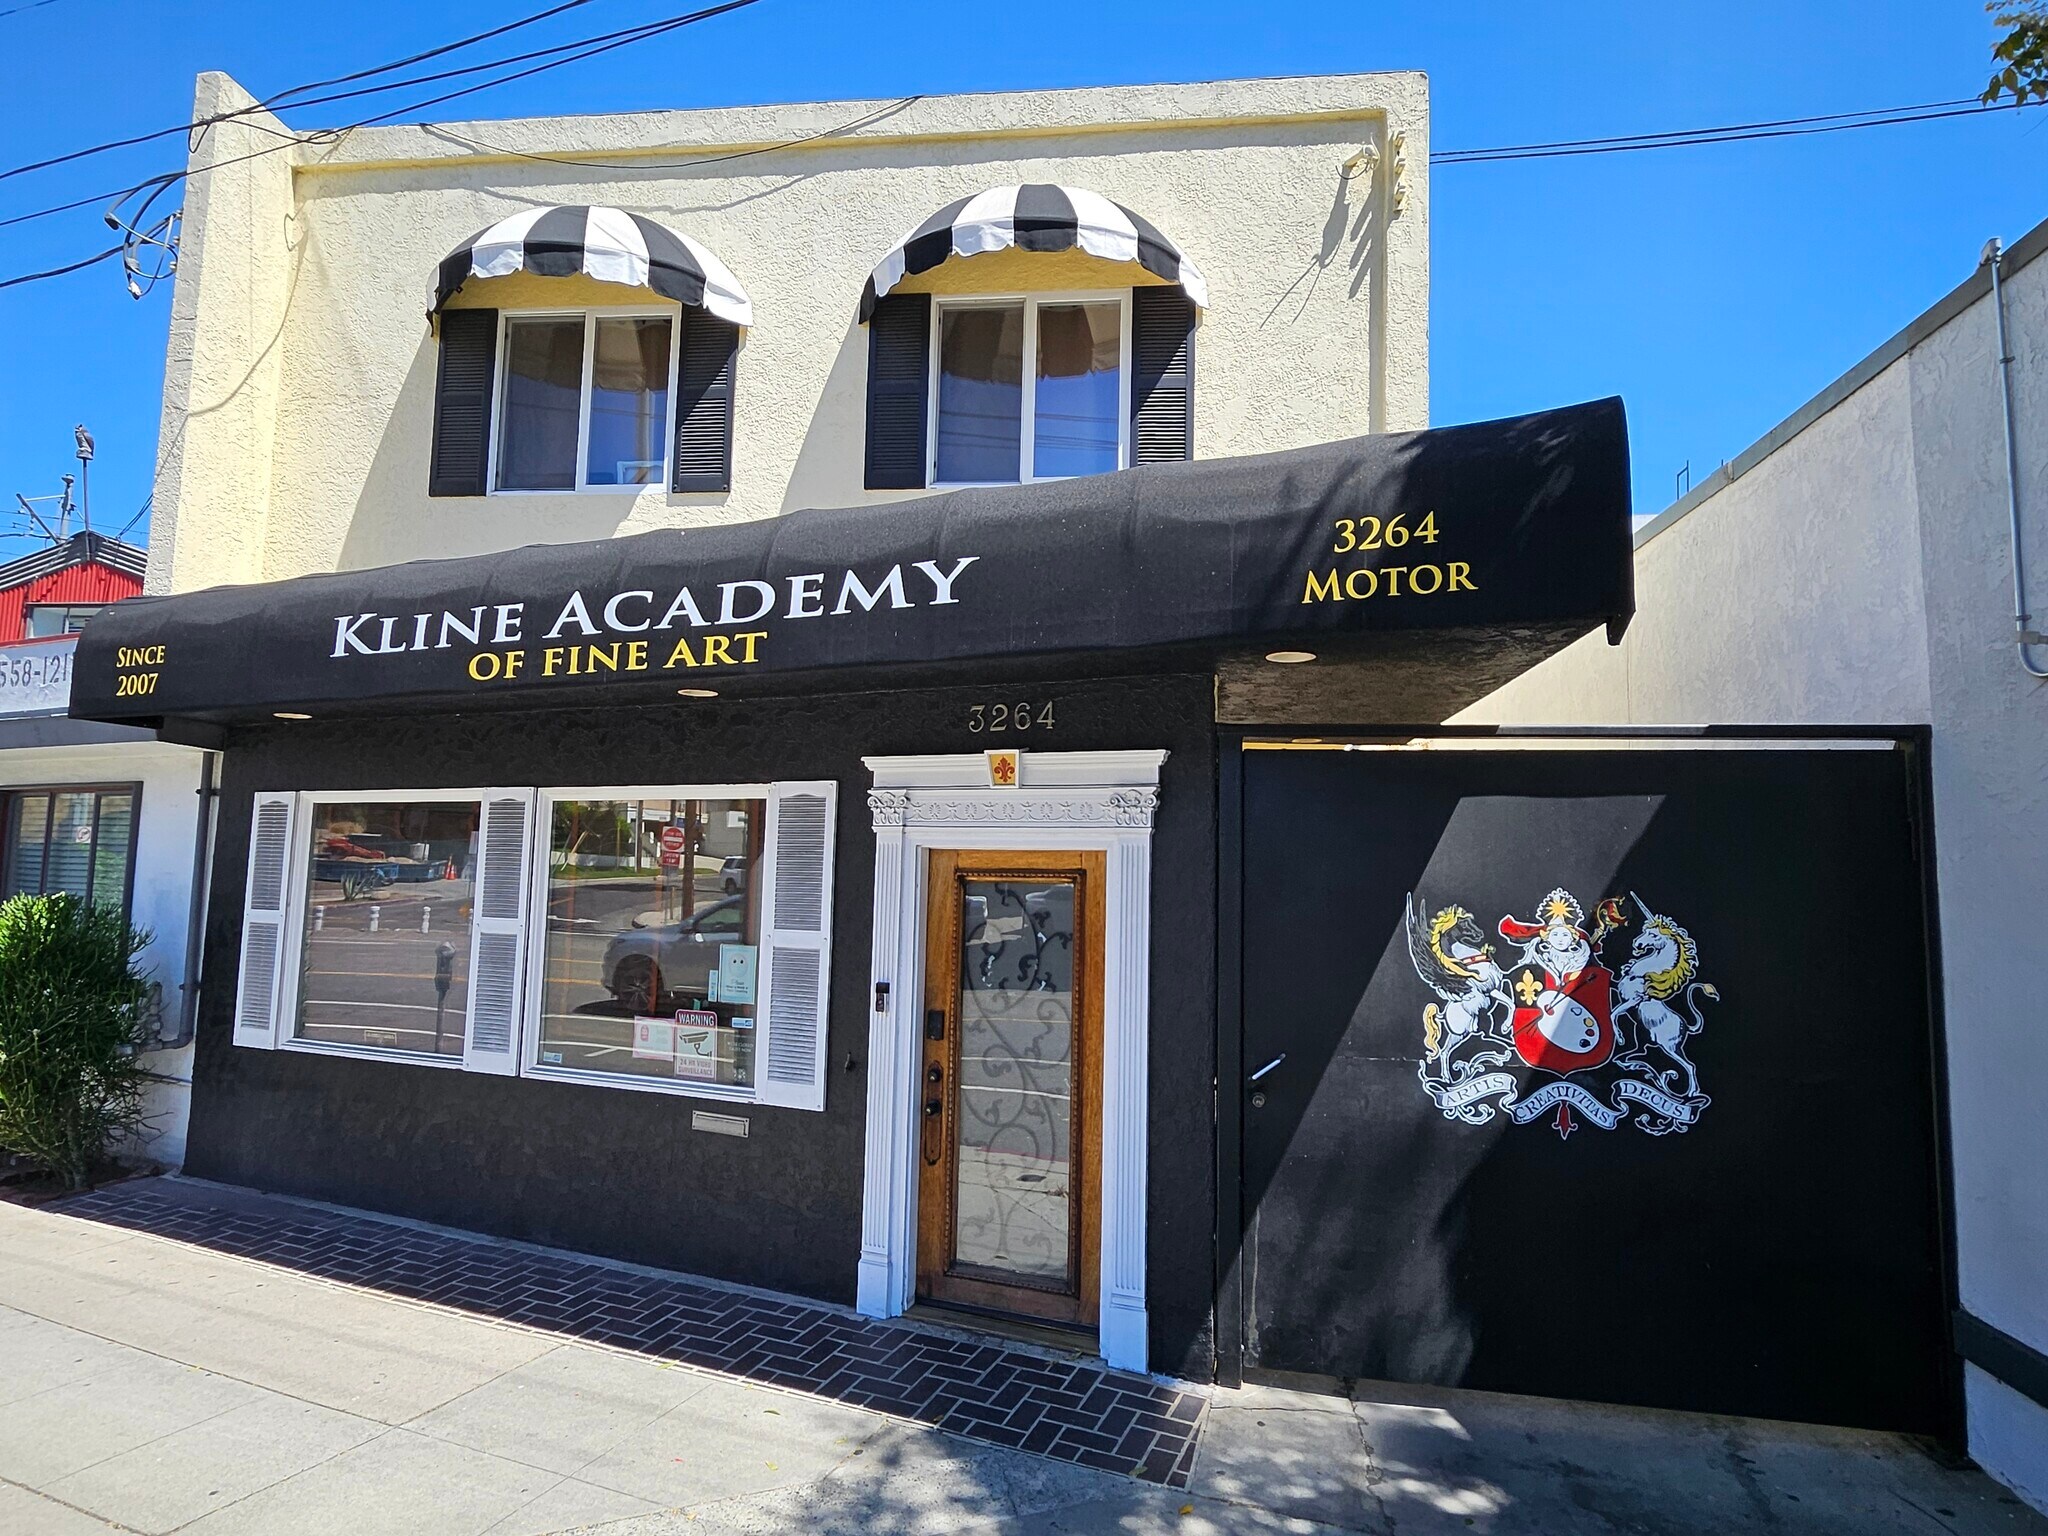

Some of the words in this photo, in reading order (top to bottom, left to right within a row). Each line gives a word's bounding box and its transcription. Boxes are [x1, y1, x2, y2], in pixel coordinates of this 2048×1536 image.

[1333, 510, 1440, 554] 3264
[1301, 561, 1479, 604] MOTOR
[329, 602, 525, 658] KLINE
[541, 556, 981, 639] ACADEMY
[116, 645, 166, 668] SINCE
[468, 650, 525, 681] OF
[541, 640, 648, 677] FINE
[662, 631, 768, 669] ART
[115, 672, 159, 696] 2007
[968, 700, 1055, 733] 3264
[679, 1013, 714, 1026] WARNING
[1444, 1076, 1505, 1106] ARTIS
[1515, 1084, 1611, 1124] CREATIVITAS
[1621, 1081, 1685, 1117] DECUS
